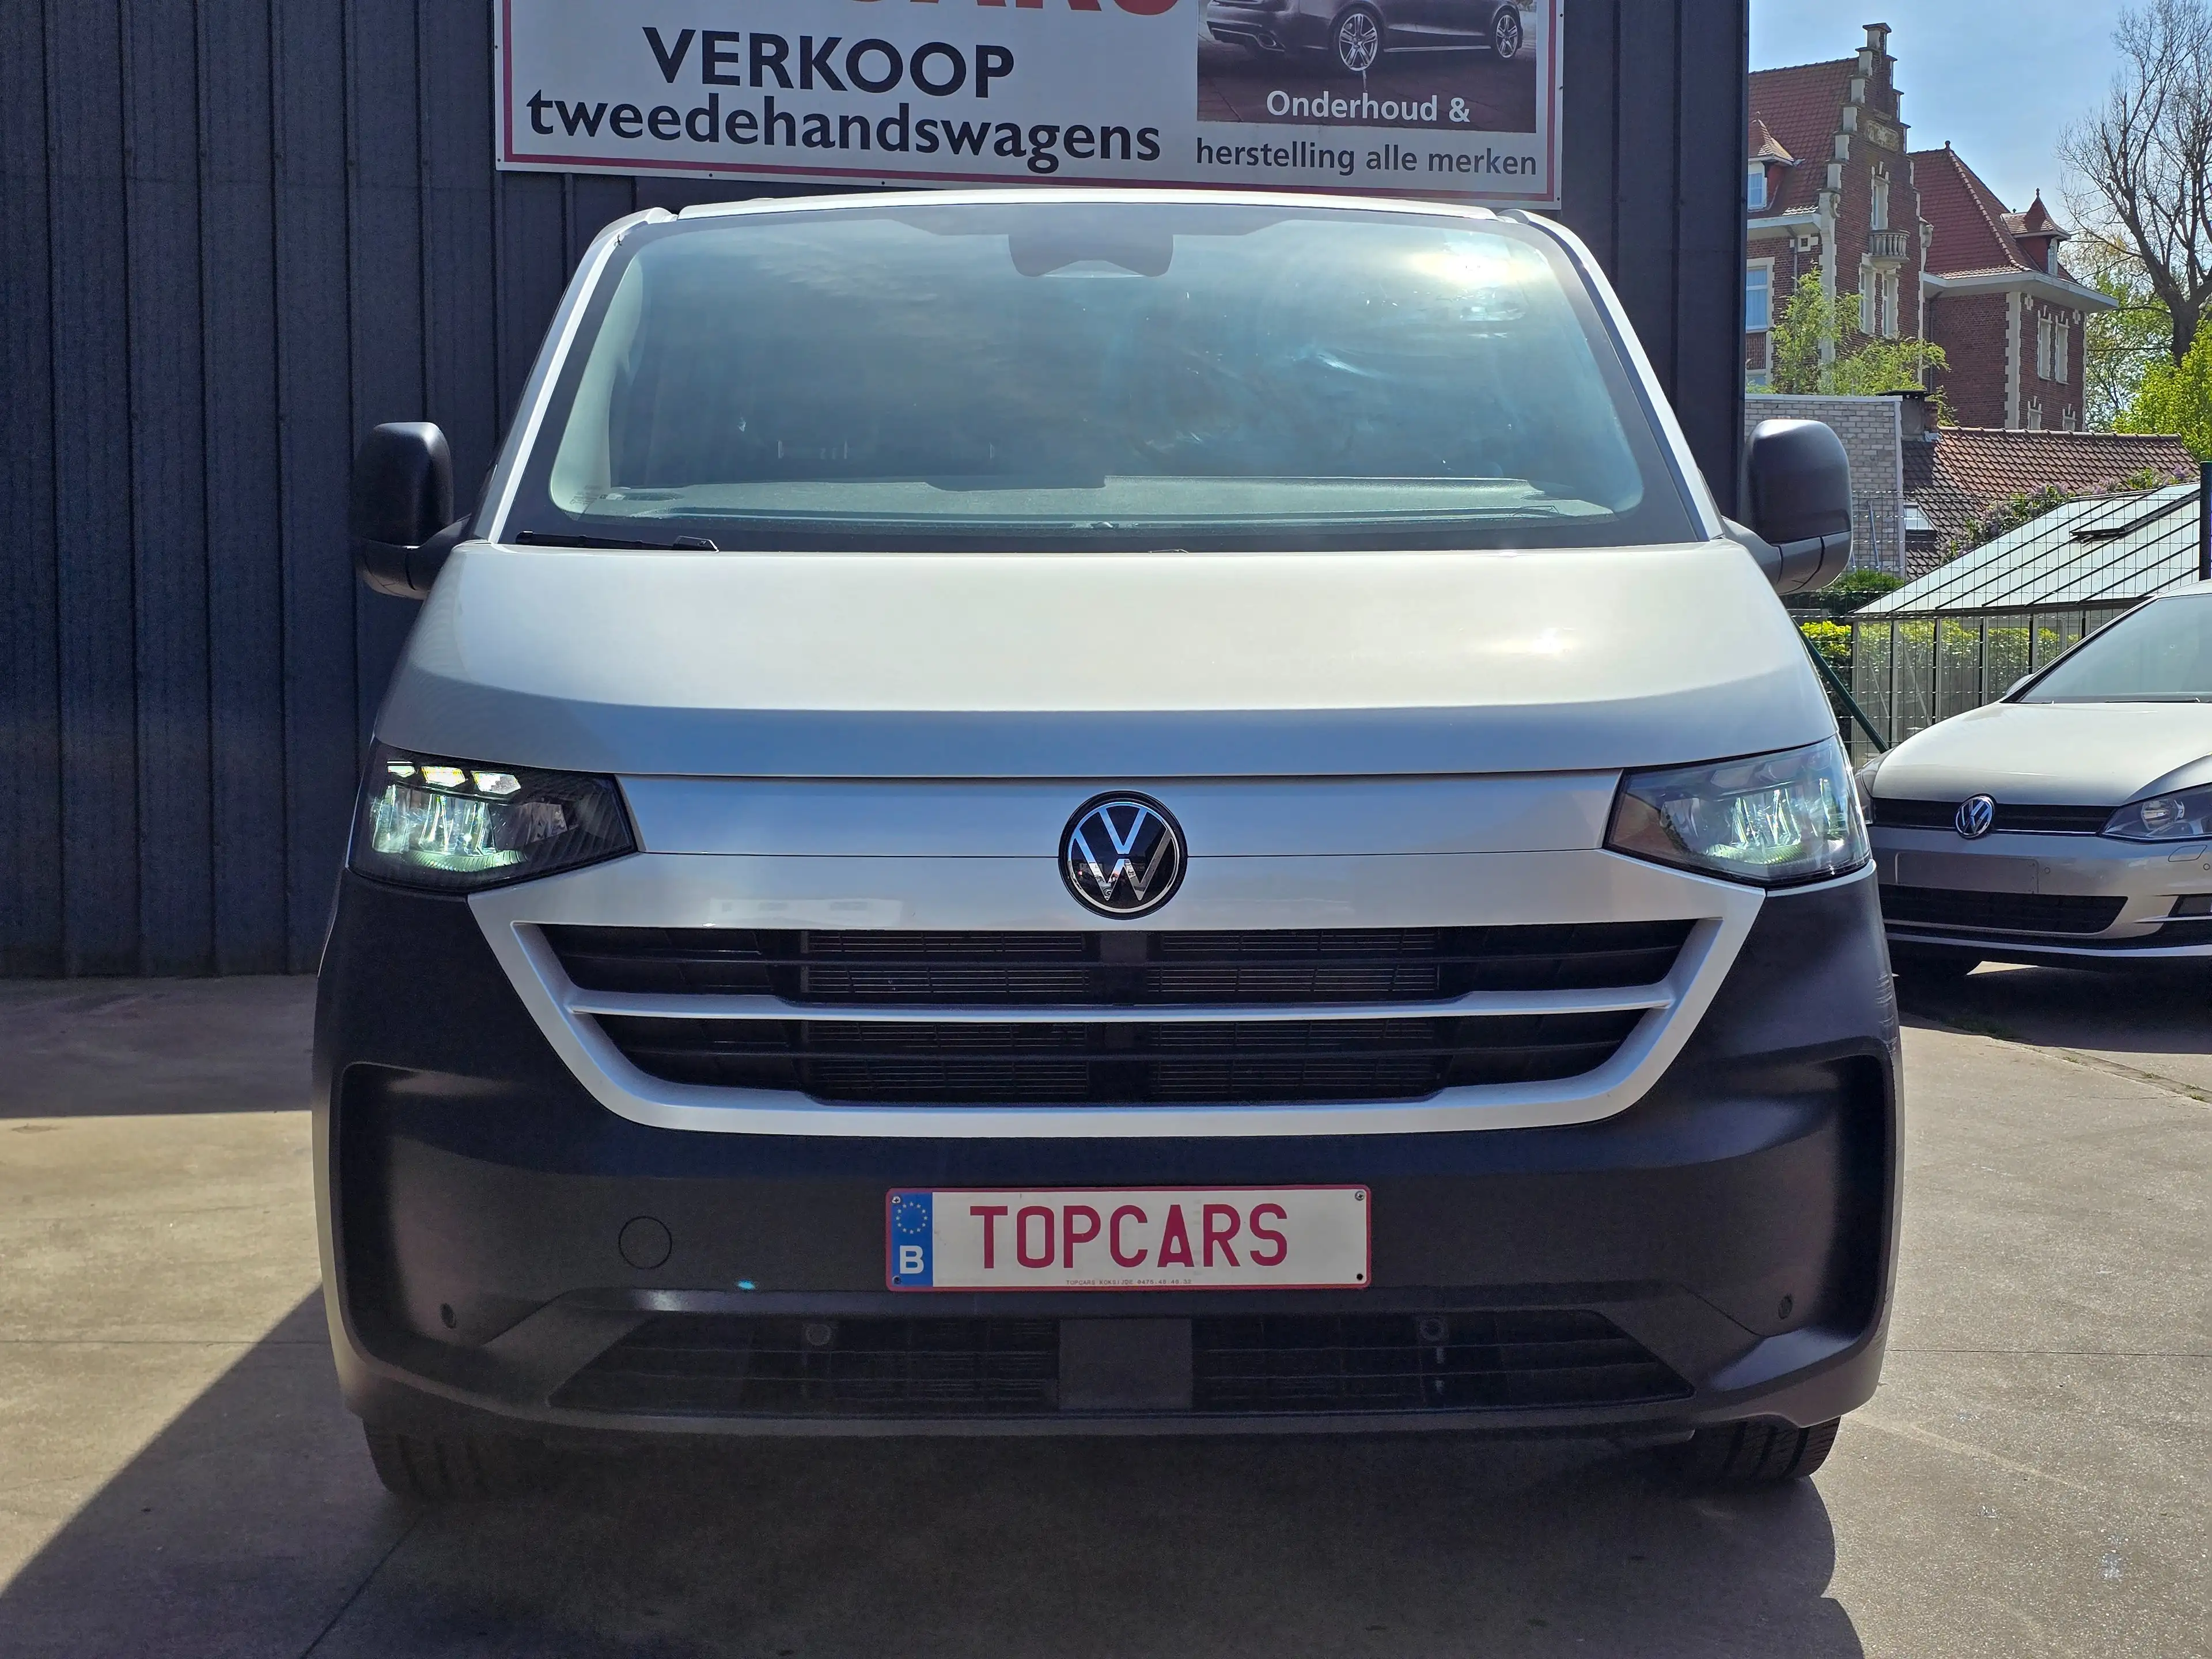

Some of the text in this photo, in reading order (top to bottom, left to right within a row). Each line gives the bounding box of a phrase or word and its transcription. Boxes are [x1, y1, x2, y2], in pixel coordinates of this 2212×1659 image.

[642, 26, 1014, 99] VERKOOP
[526, 89, 1161, 174] tweedehandswagens
[1267, 90, 1470, 123] Onderhoud &
[1196, 137, 1536, 176] herstelling alle merken
[1070, 803, 1176, 902] VW
[900, 1245, 924, 1274] B
[970, 1204, 1287, 1268] TOPCARS
